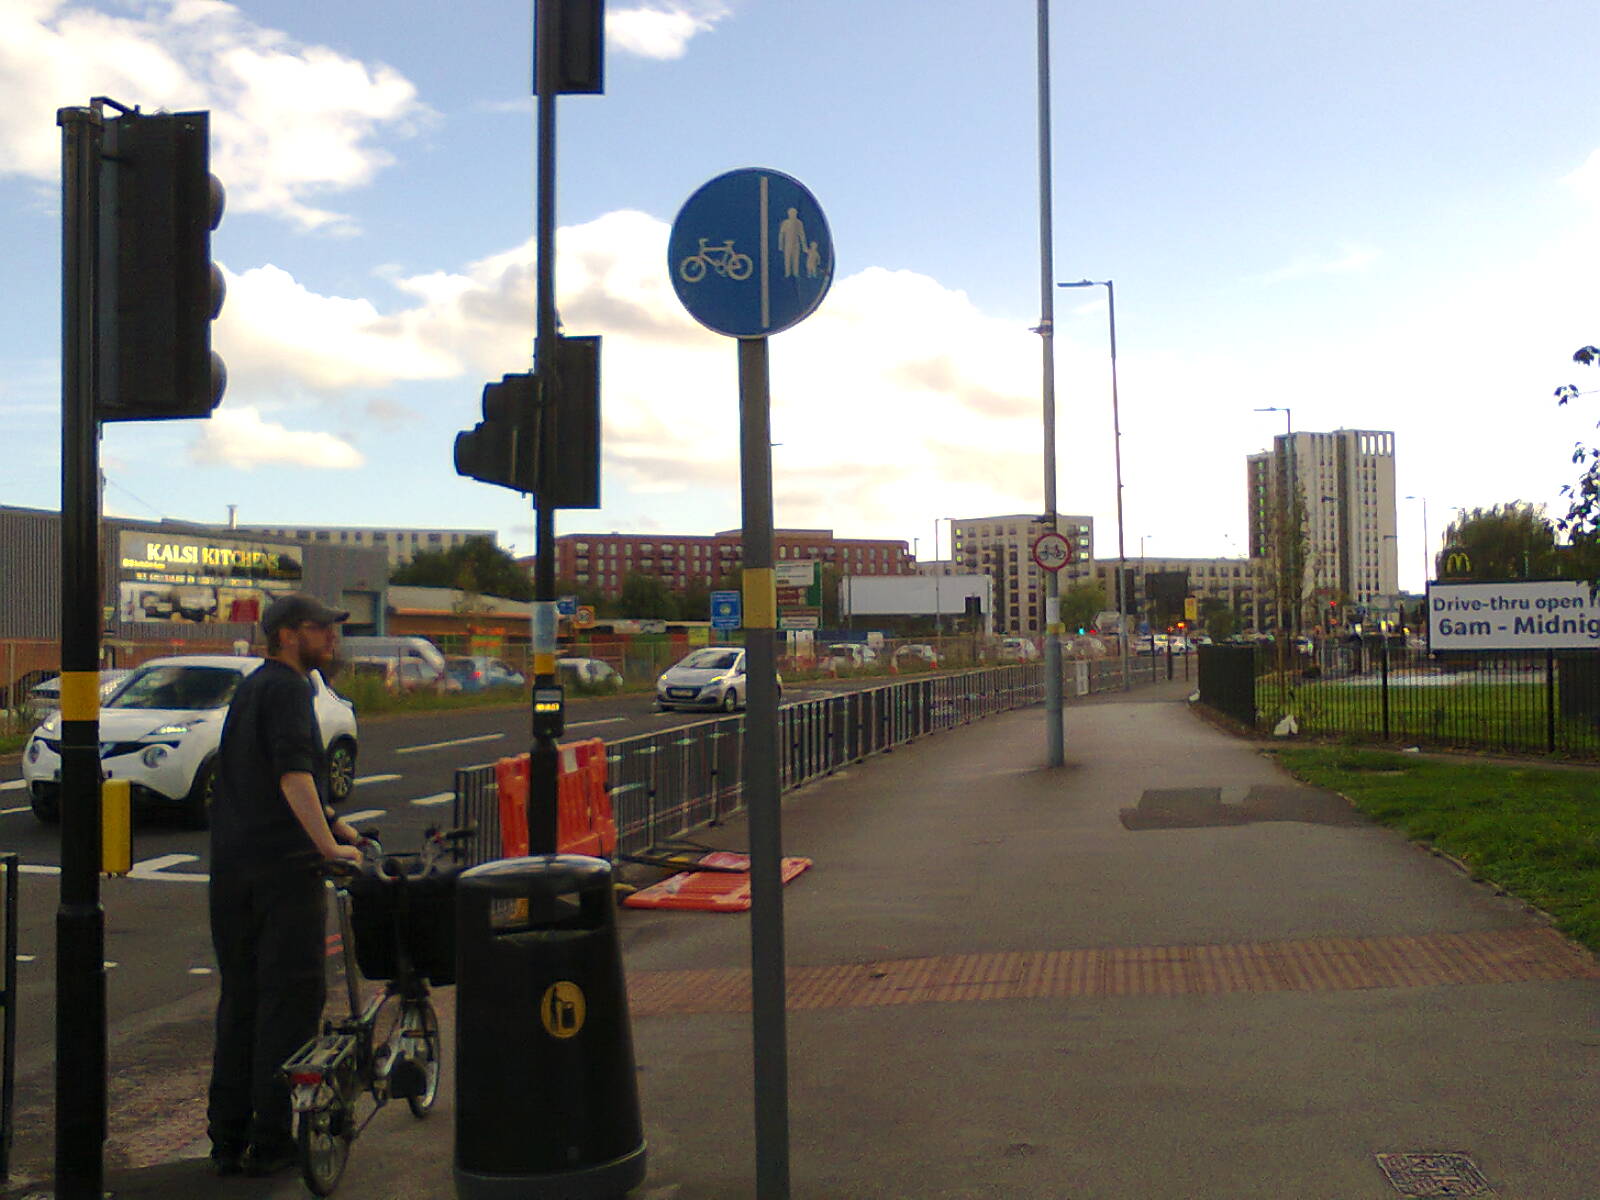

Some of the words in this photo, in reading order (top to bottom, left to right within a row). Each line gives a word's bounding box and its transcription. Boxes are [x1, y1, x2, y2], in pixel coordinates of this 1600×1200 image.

[147, 543, 198, 564] KALSI
[1432, 596, 1530, 611] Drive-thru
[1535, 597, 1583, 612] open
[1439, 617, 1491, 636] 6am
[1513, 613, 1600, 639] Midnig
